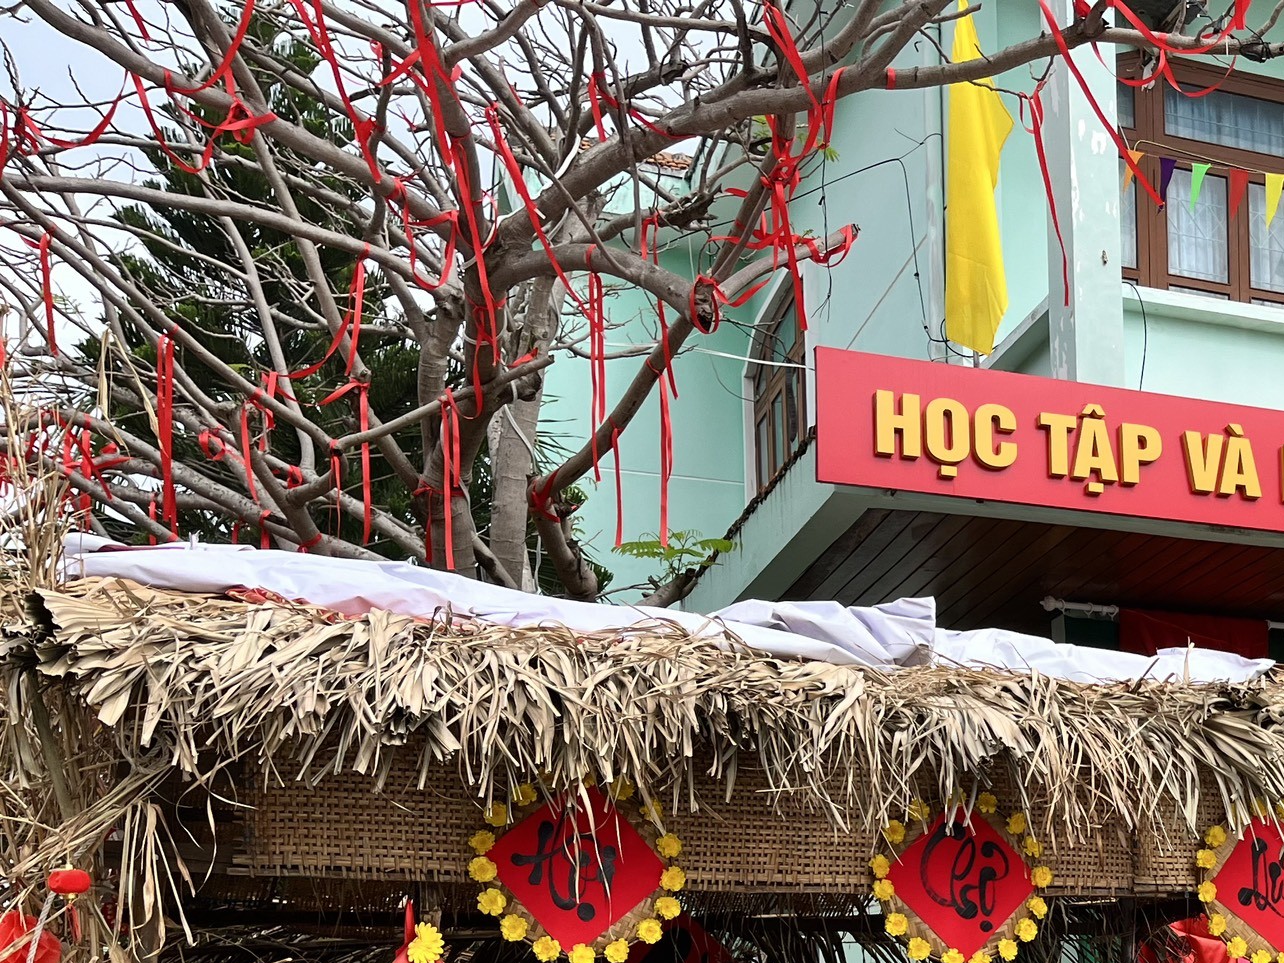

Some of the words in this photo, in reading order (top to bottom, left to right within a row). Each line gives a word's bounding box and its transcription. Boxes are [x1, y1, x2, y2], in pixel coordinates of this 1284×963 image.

[874, 388, 1018, 479] HỌC
[1037, 403, 1163, 496] TẬP
[1180, 422, 1263, 499] VÀ
